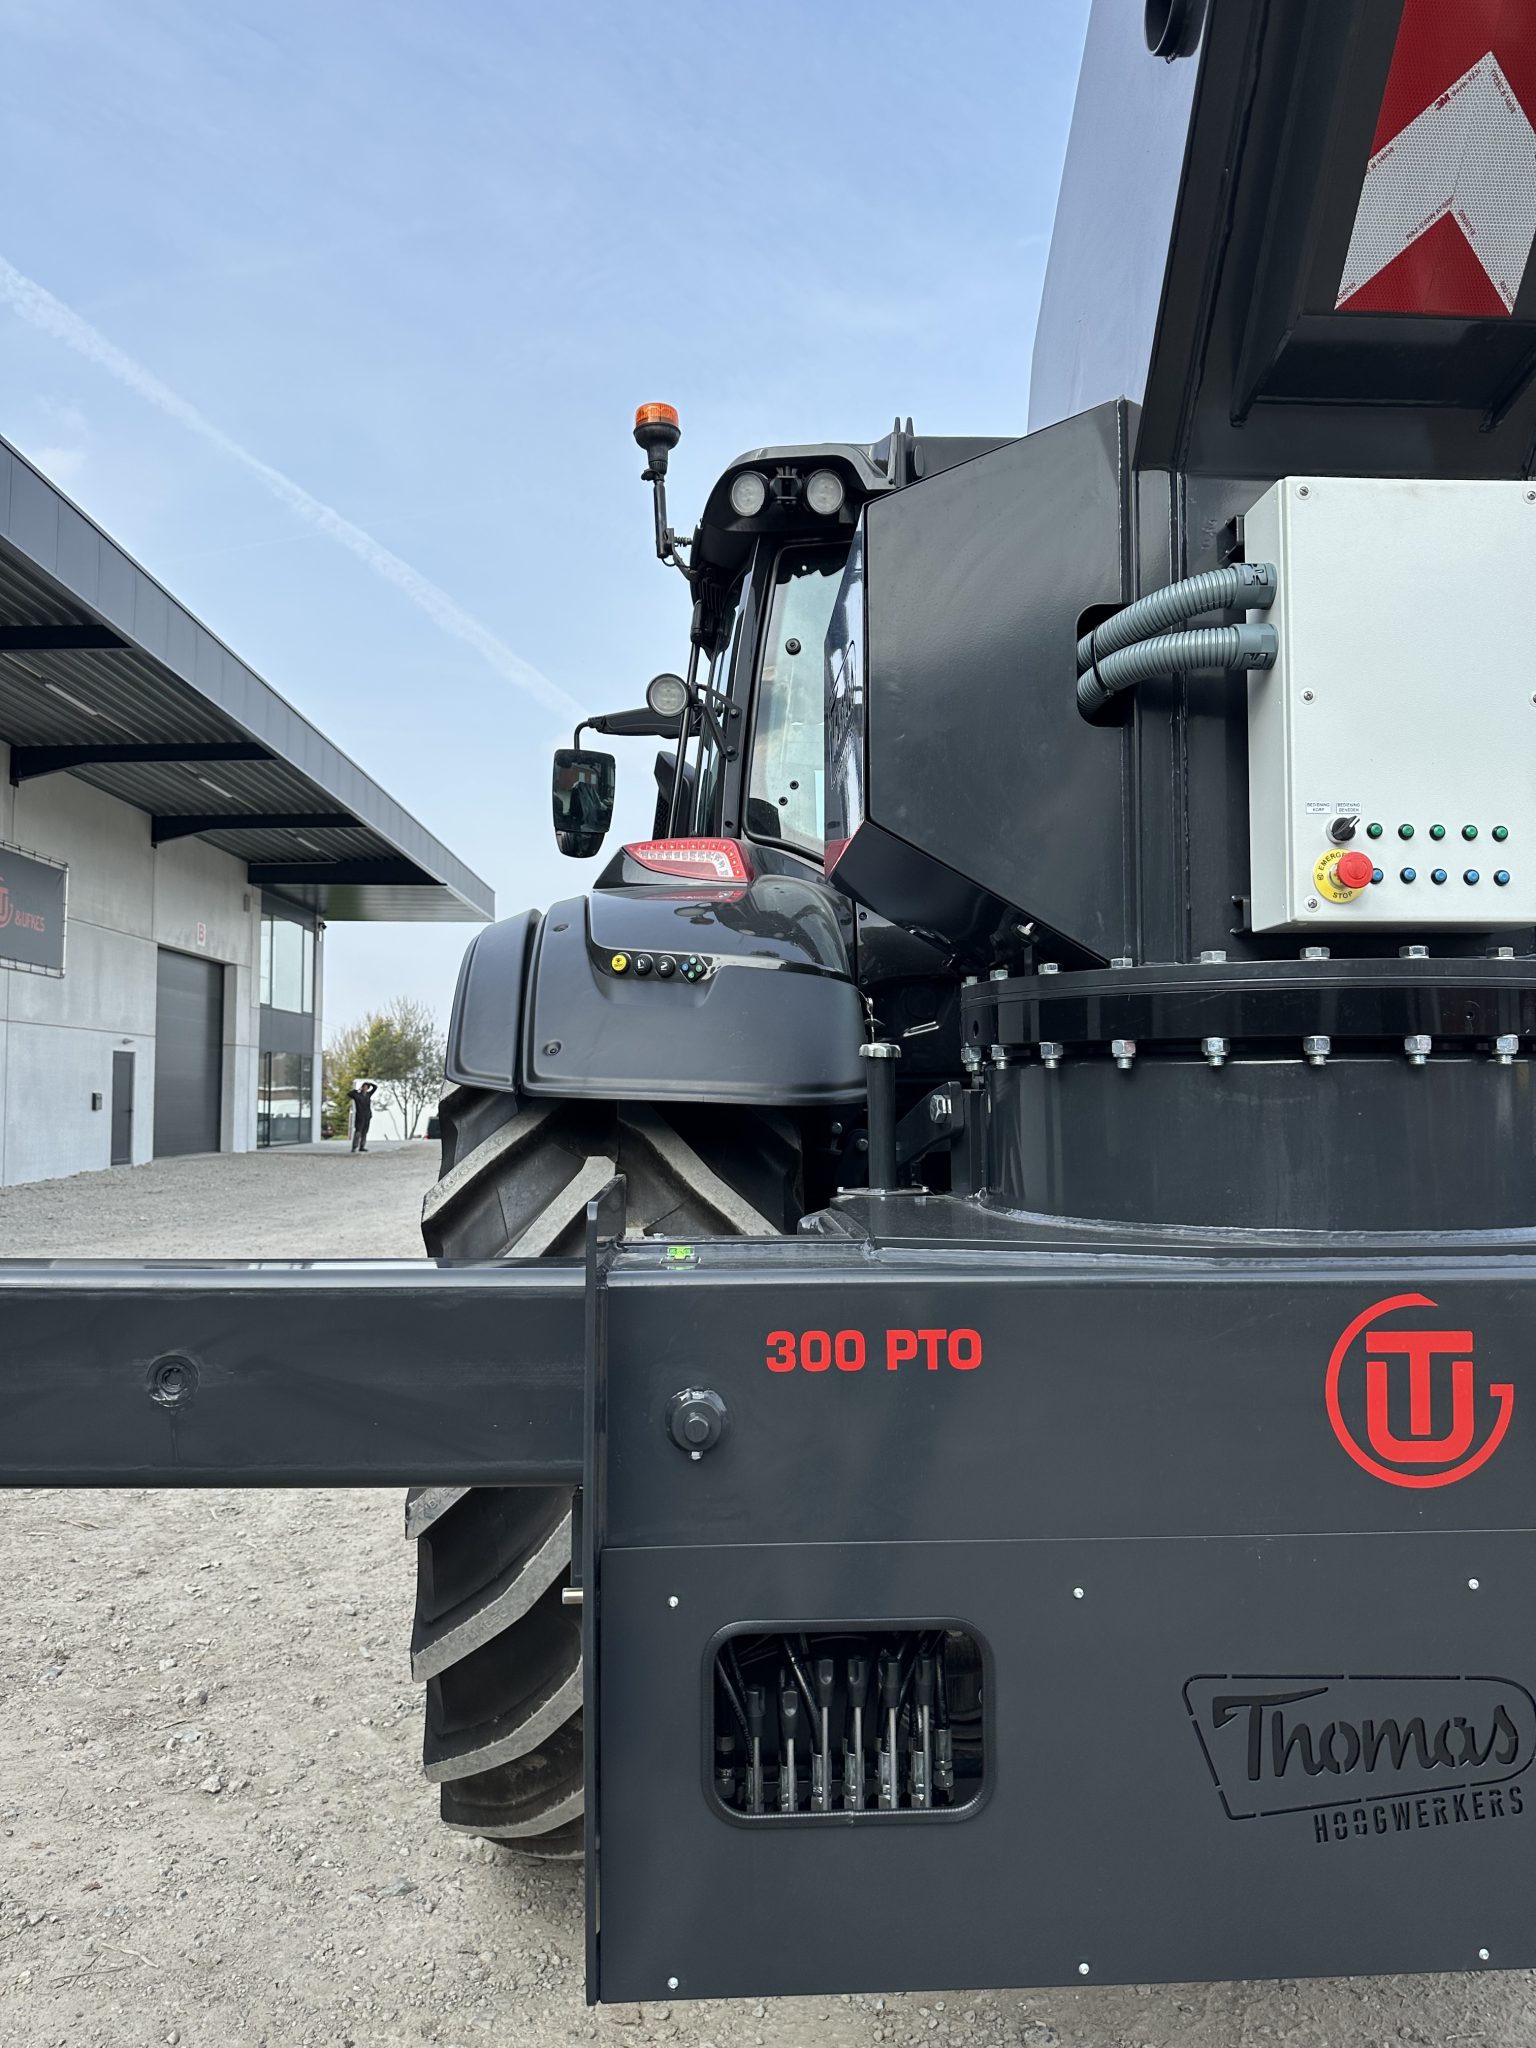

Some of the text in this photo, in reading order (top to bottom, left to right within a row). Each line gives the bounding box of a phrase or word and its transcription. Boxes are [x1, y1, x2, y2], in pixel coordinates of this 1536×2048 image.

[1434, 93, 1451, 111] 3M
[1332, 890, 1353, 899] STOP
[766, 1329, 982, 1373] 300 PTO
[1212, 1686, 1519, 1781] Thomas
[1314, 1785, 1524, 1843] HOOGWERKERS
